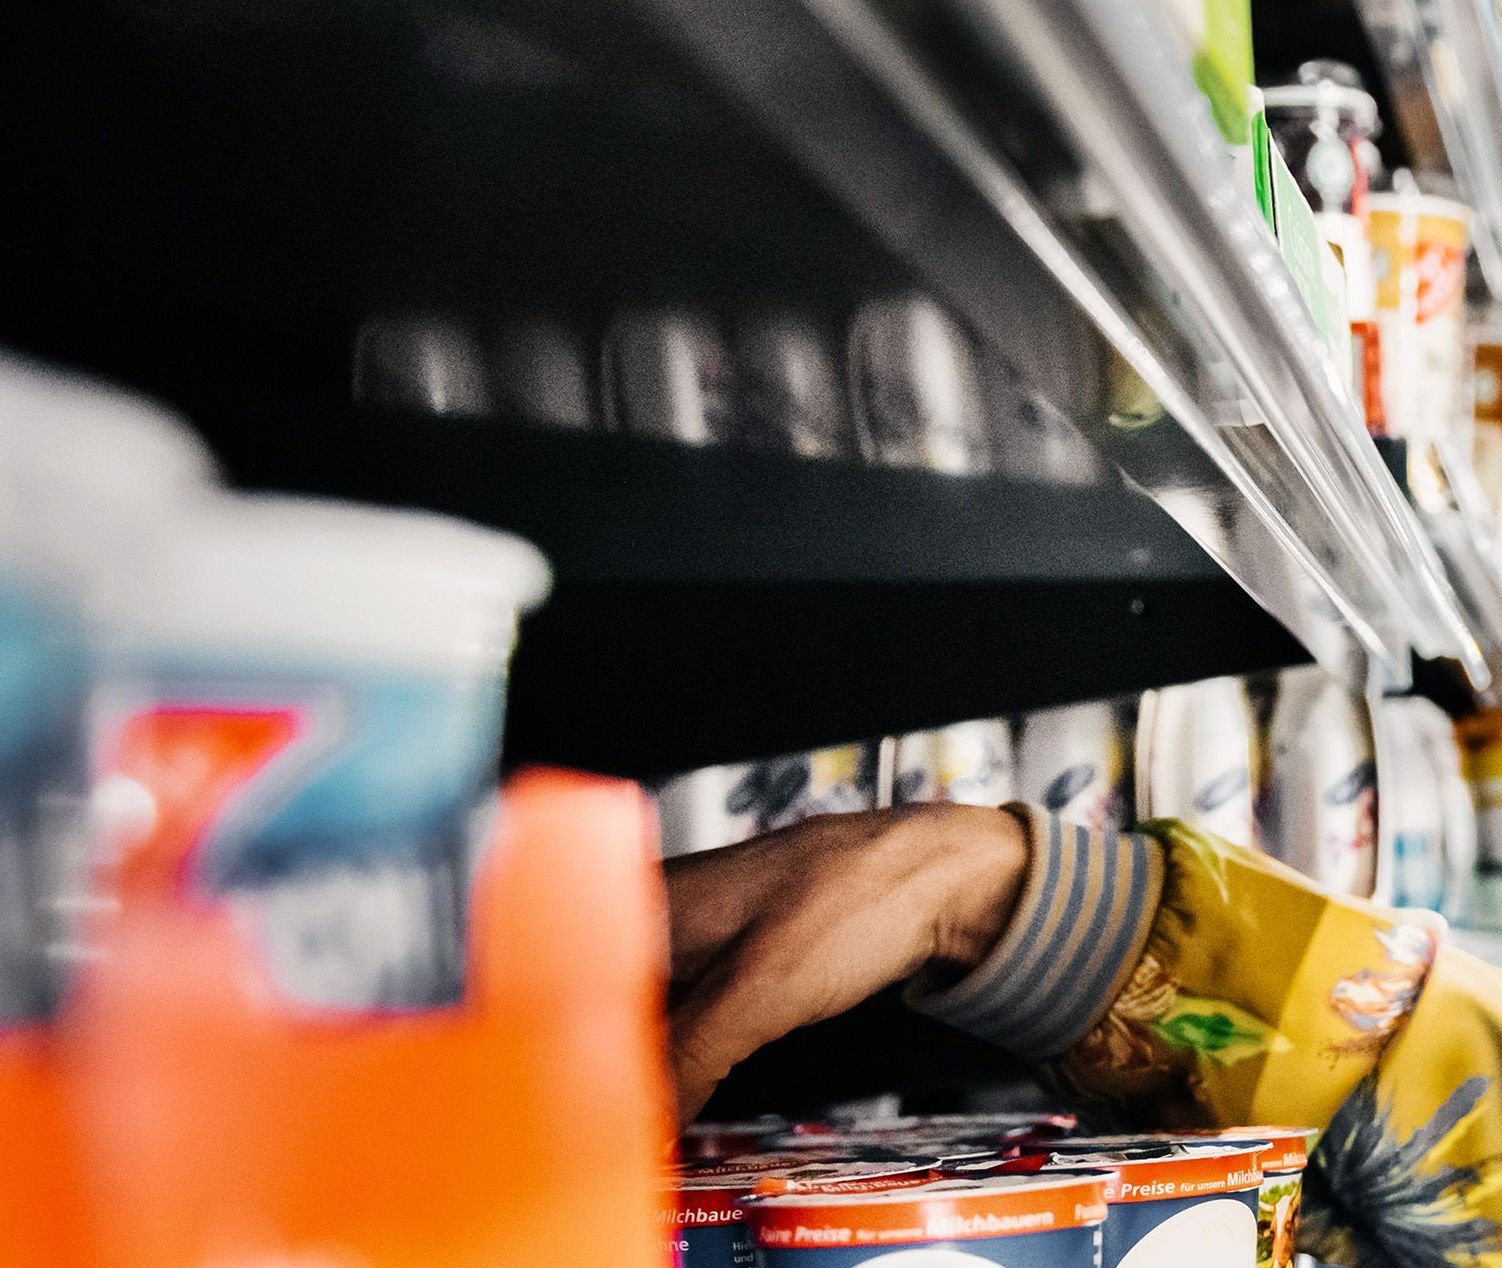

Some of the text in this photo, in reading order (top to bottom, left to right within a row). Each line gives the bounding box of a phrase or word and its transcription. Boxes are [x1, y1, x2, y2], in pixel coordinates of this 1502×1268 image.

[1120, 1180, 1175, 1198] Preise
[1180, 1182, 1195, 1193] für
[1197, 1179, 1226, 1191] unsere
[794, 1226, 851, 1243] Preise
[734, 1253, 754, 1263] und
